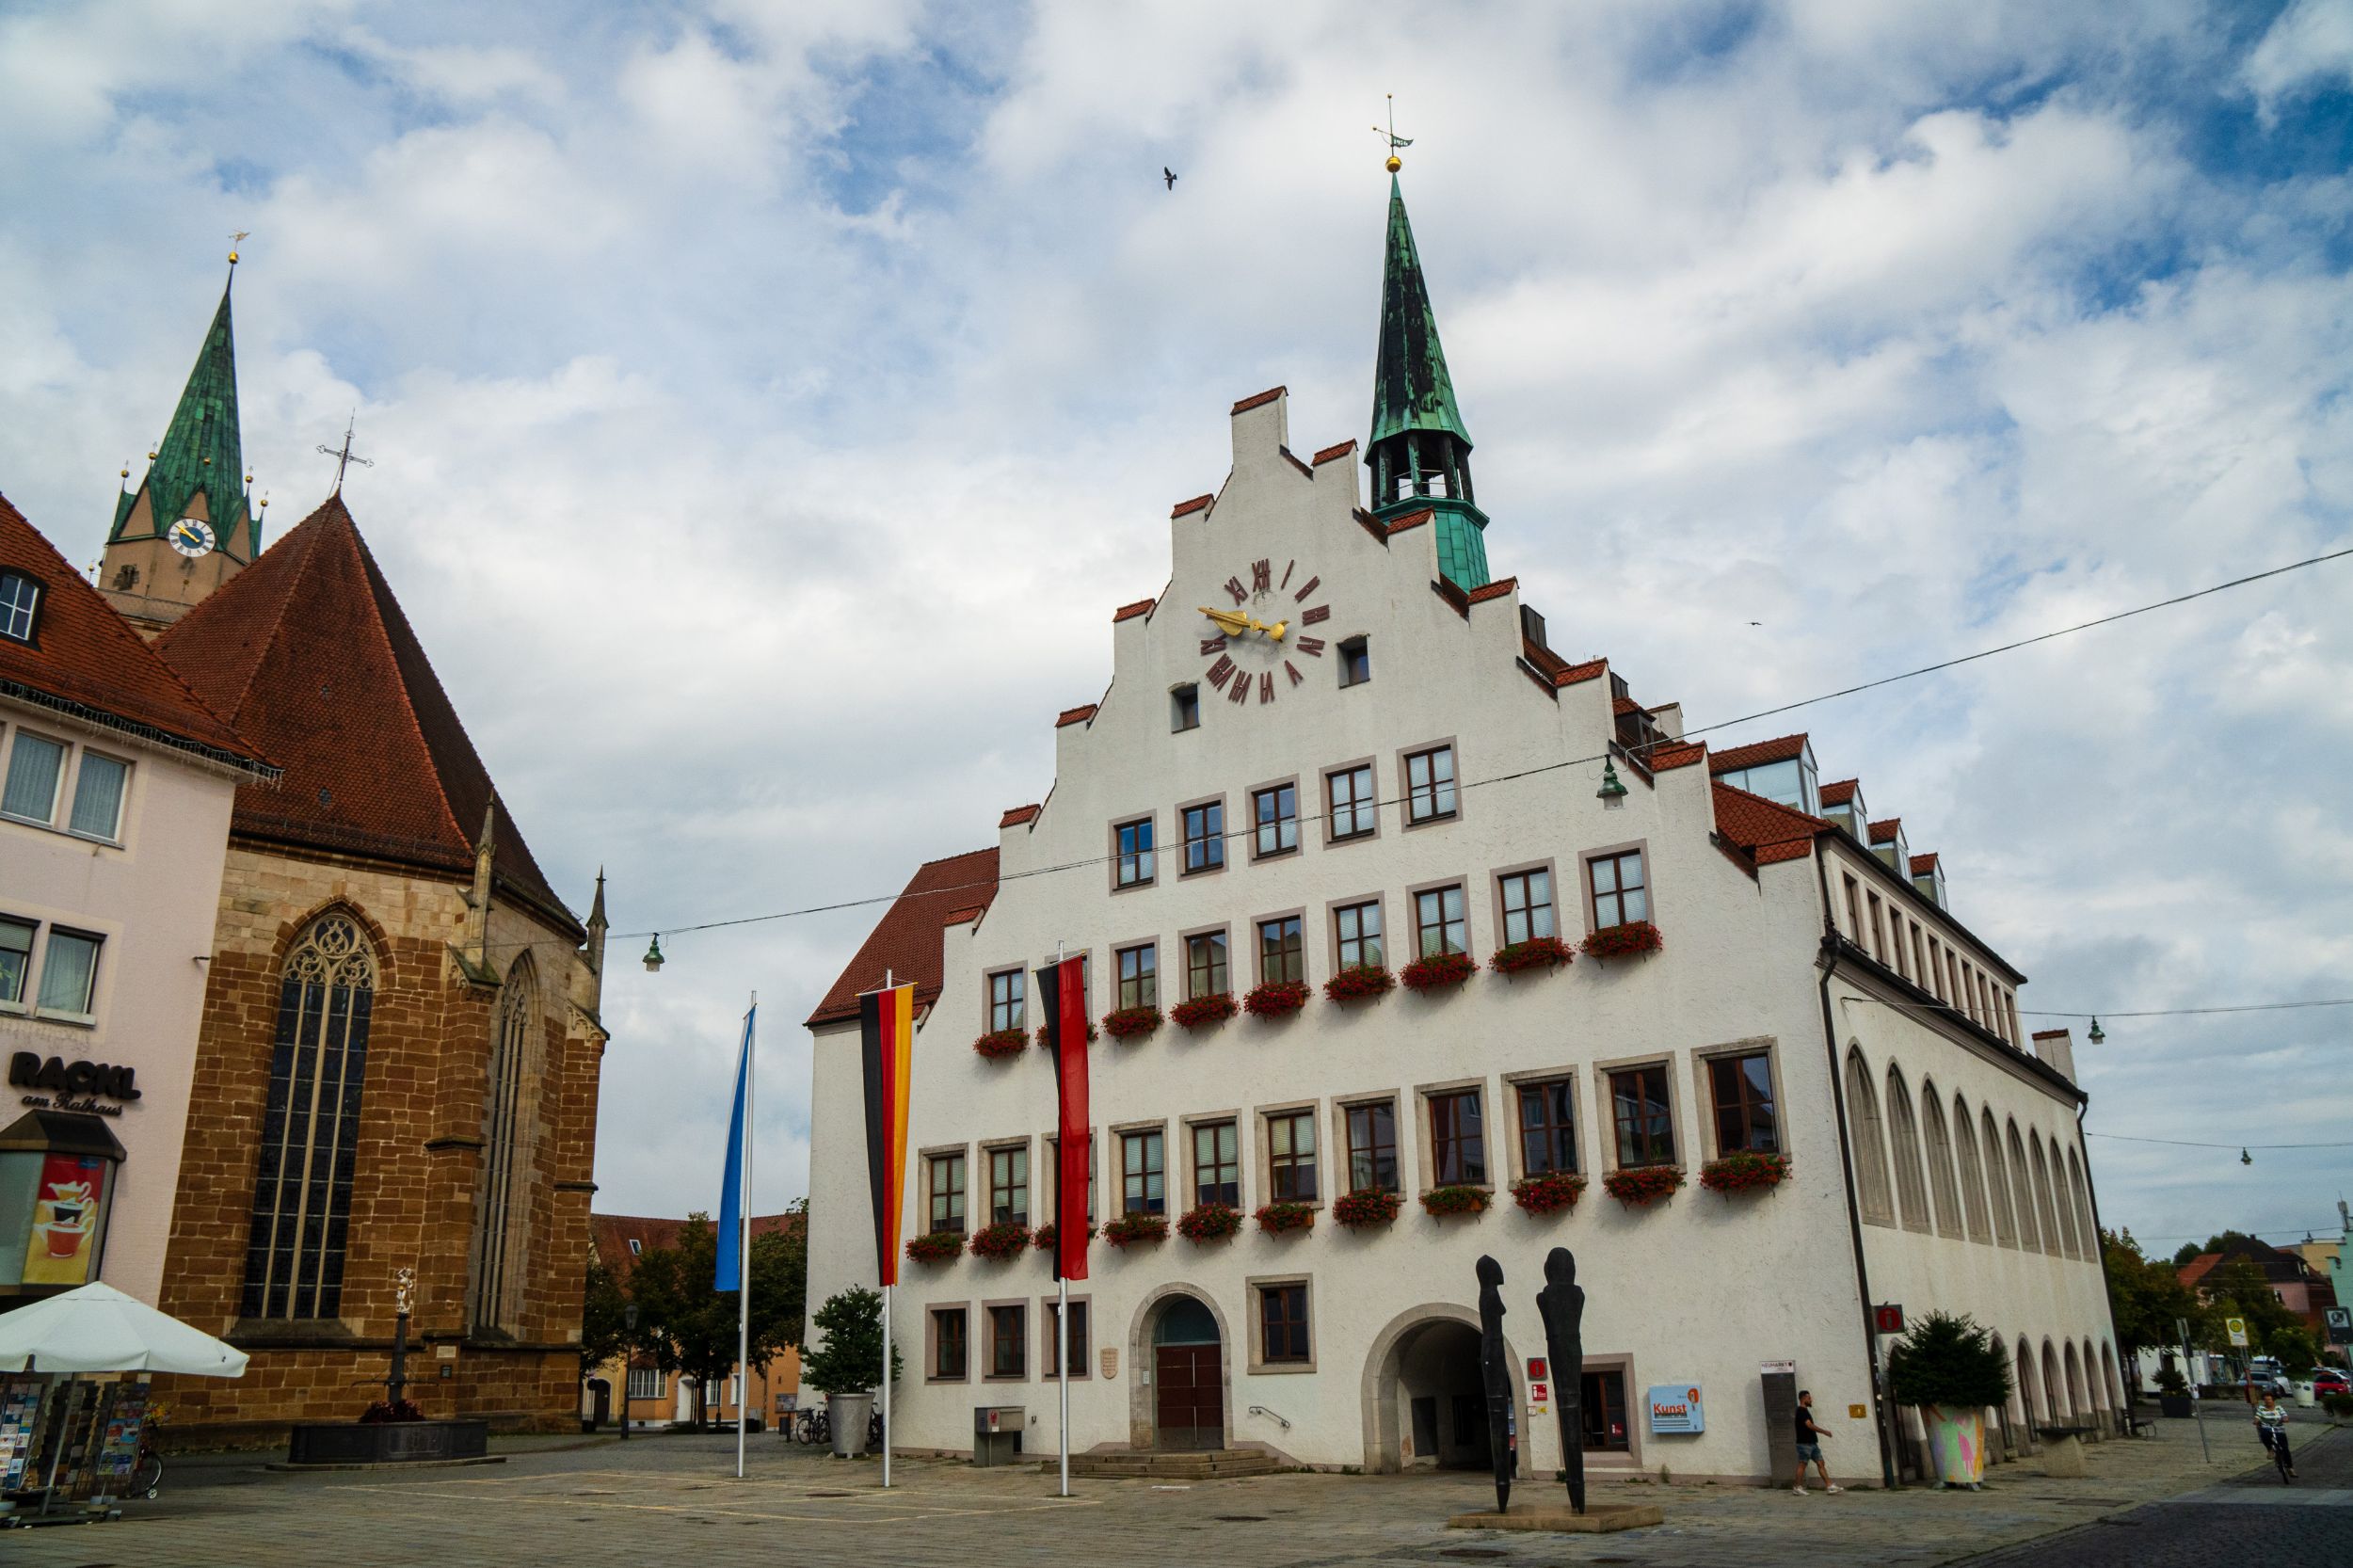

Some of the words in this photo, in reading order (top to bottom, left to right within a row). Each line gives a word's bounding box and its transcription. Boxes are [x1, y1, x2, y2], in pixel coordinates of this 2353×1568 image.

[9, 1051, 141, 1100] RACKL
[22, 1096, 50, 1107] am
[1653, 1403, 1687, 1416] Kunst
